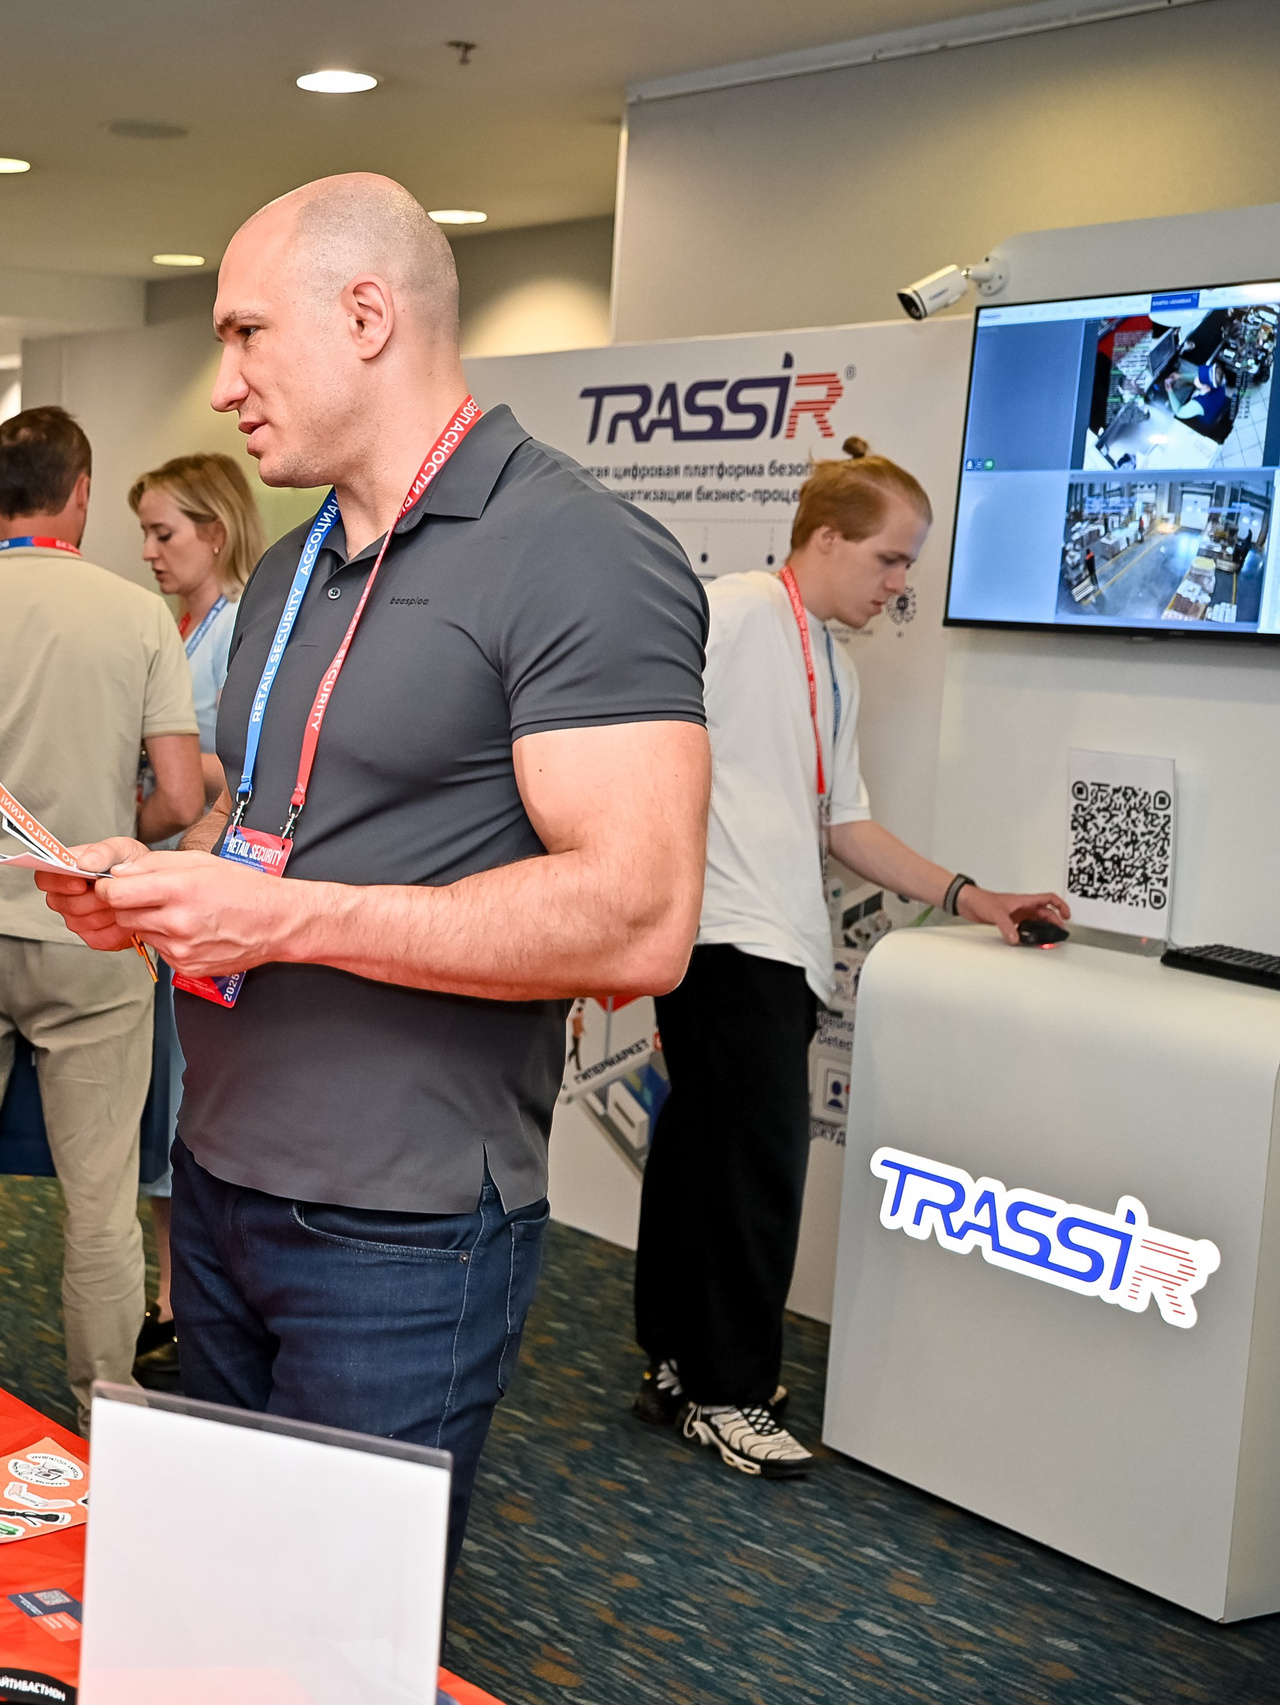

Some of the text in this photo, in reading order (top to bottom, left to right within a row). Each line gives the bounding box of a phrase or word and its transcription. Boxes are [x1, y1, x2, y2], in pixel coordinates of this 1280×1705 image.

[579, 351, 845, 444] TRASSIR
[613, 462, 681, 481] цифровая
[682, 461, 765, 481] платформа
[695, 484, 801, 505] бизнес-проце
[300, 494, 339, 576] АССОЦИА
[252, 588, 303, 723] RETAIL SECURITY
[226, 838, 251, 857] RETAIL
[249, 844, 285, 867] SECURITY
[880, 1159, 1197, 1315] TRASSIR
